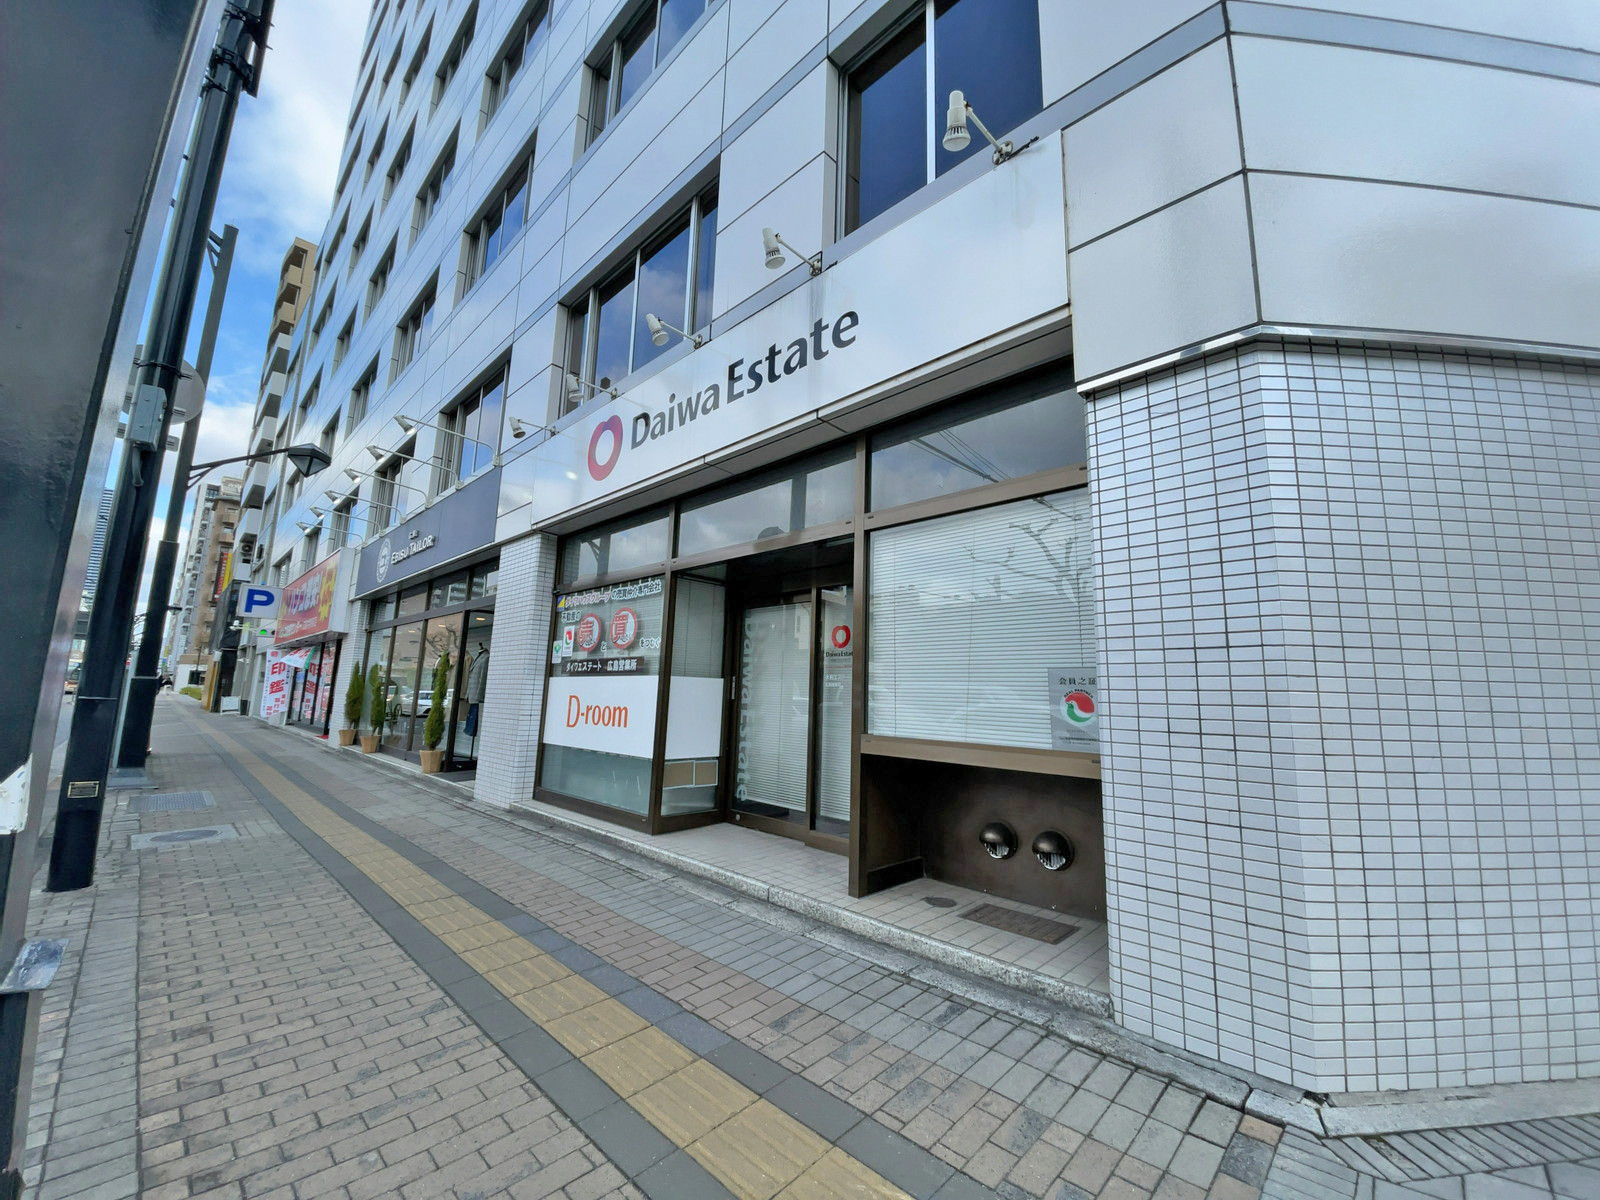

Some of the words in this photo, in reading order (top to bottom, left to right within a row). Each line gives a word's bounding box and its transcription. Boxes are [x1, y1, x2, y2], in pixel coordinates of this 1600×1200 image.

[630, 383, 721, 450] Daiwa
[726, 310, 860, 405] Estate
[391, 546, 409, 564] EBISU
[409, 535, 435, 555] TAILOR
[244, 588, 275, 613] P
[566, 659, 602, 672] ダイワエステート
[566, 694, 629, 729] D-room
